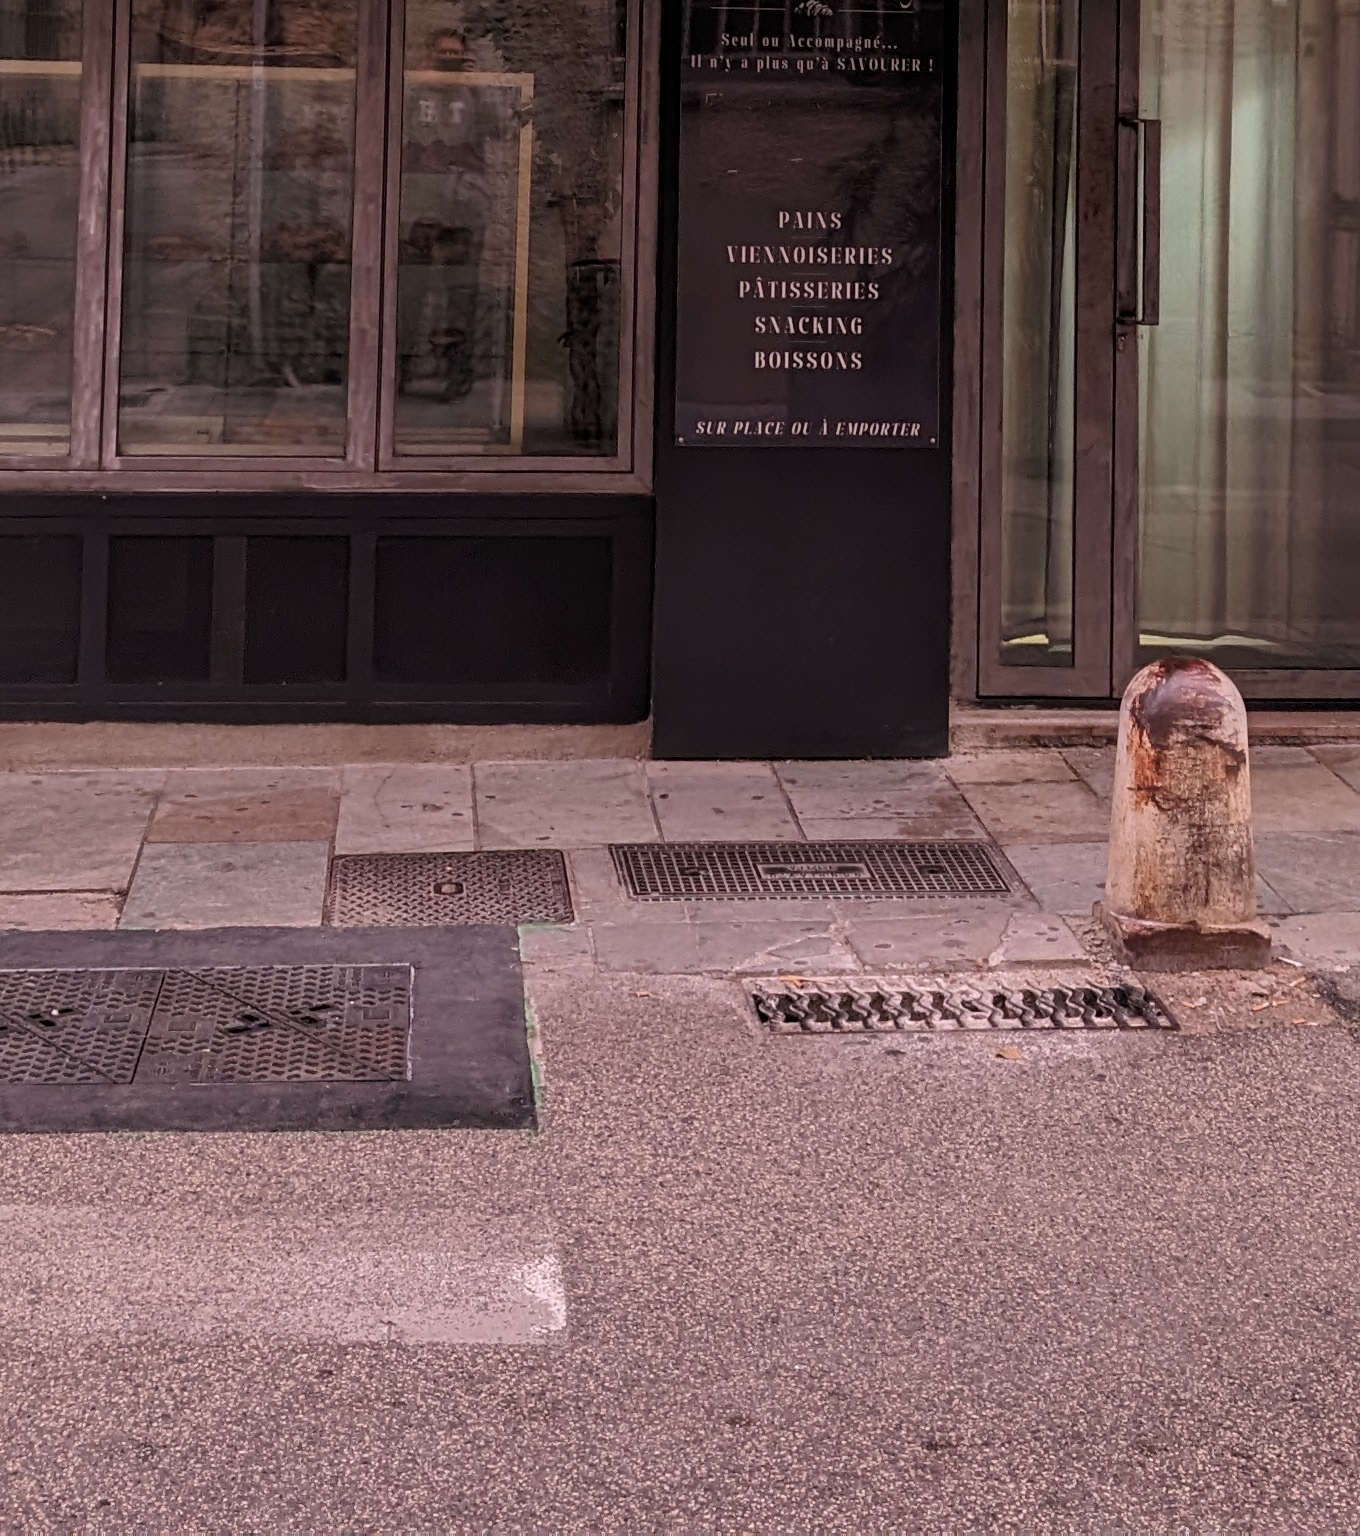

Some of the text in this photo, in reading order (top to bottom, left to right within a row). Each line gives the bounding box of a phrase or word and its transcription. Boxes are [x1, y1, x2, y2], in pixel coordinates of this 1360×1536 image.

[721, 33, 754, 47] Seul
[762, 37, 779, 47] ou
[741, 59, 748, 69] a
[757, 56, 788, 73] plus
[837, 57, 921, 72] SAVOURER
[778, 211, 842, 229] PAINS
[727, 245, 892, 265] VIENNOISERIES
[739, 276, 880, 300] PÂTISSERIES
[754, 316, 863, 335] SNACKING
[754, 351, 863, 370] BOISSONS
[695, 418, 921, 437] SUR PLACE OU À EMPORTER
